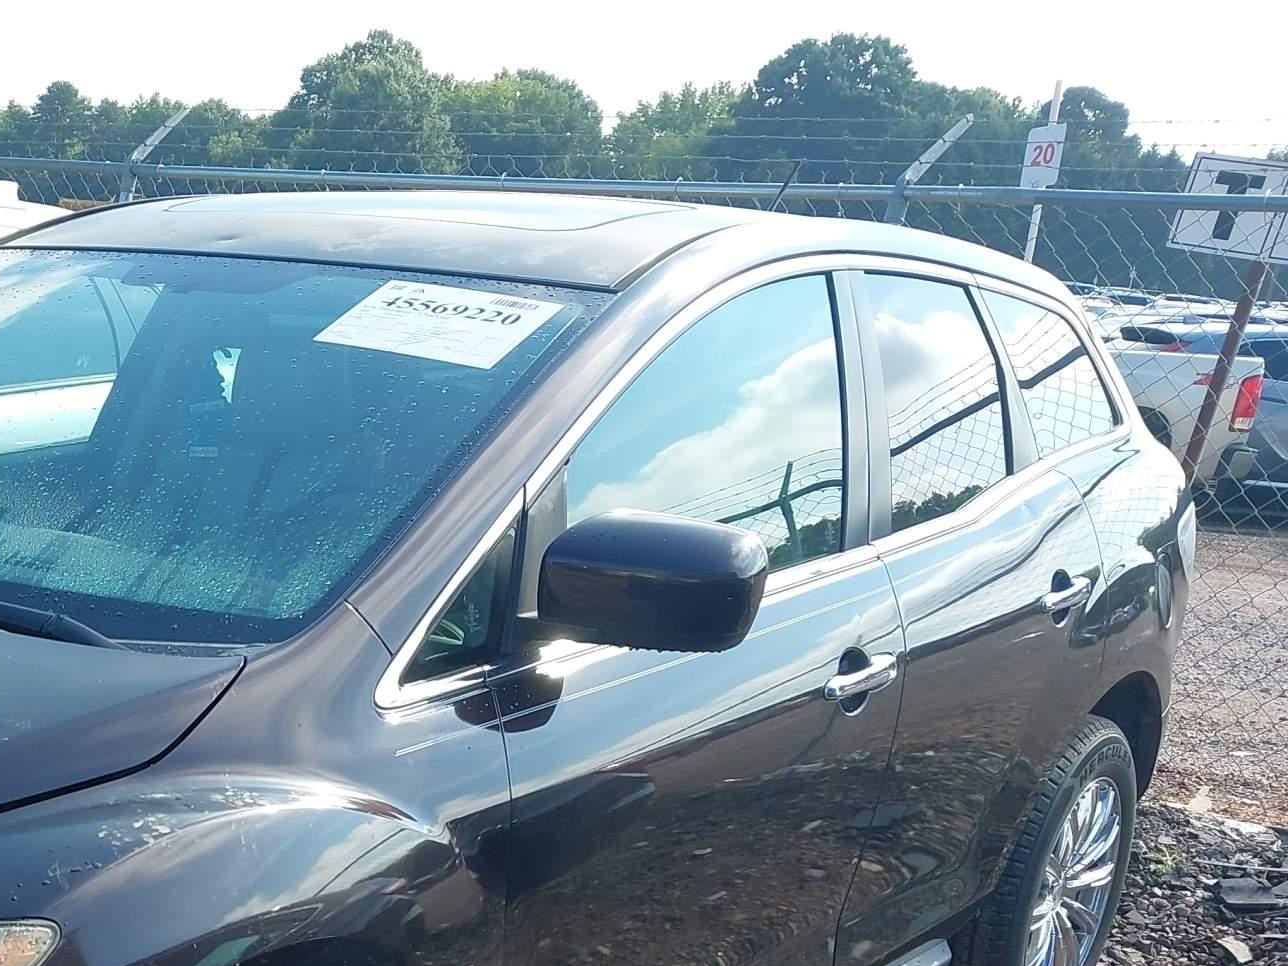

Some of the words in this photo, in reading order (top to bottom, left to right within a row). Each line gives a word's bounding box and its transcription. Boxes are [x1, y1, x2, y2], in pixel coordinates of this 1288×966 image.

[1030, 143, 1056, 167] 20
[1212, 171, 1267, 241] T
[382, 296, 522, 326] 45569220
